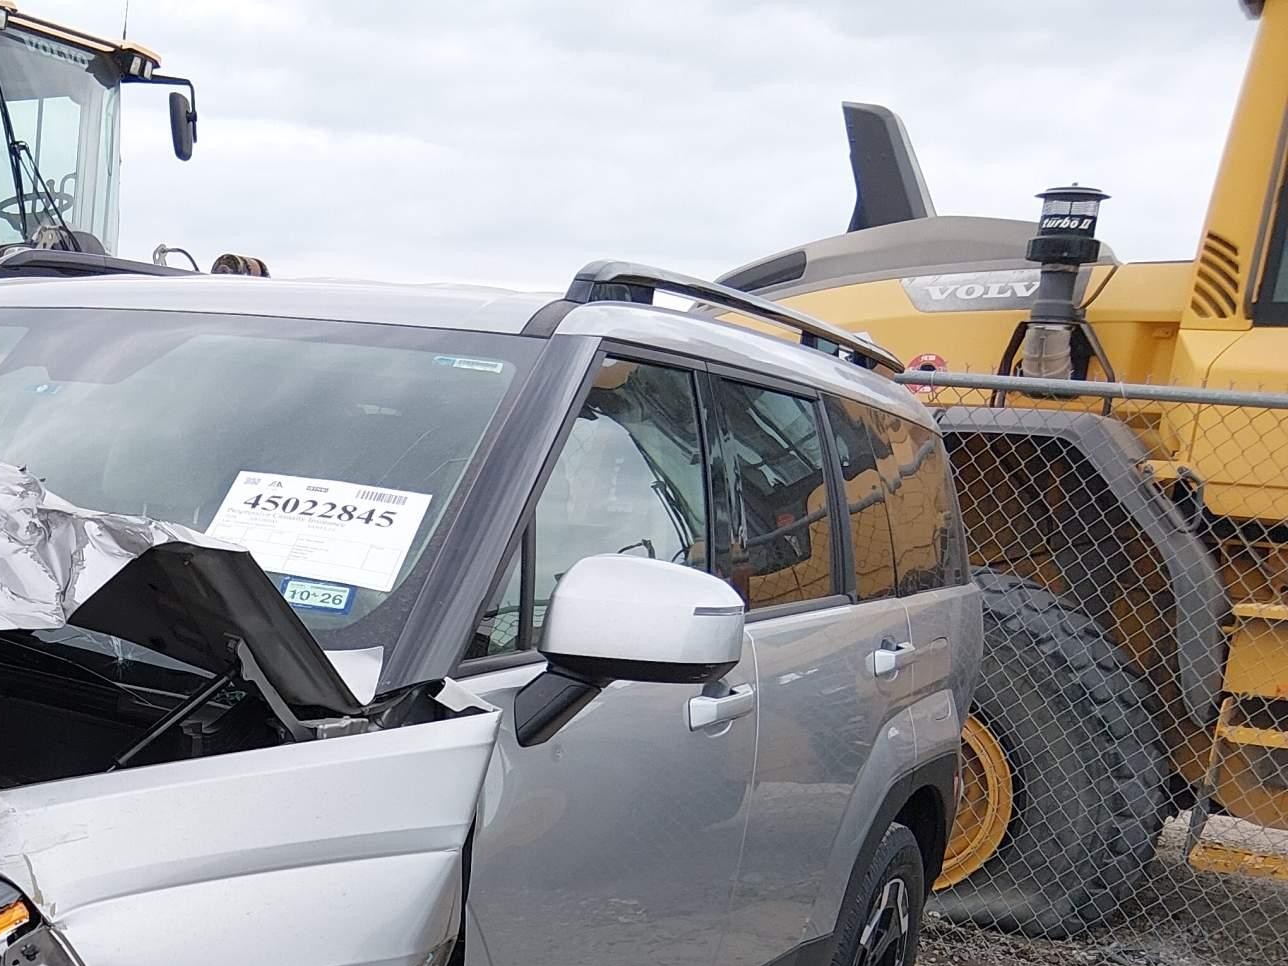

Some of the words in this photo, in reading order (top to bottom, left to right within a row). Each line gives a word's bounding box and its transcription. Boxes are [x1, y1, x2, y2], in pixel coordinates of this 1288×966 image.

[1041, 216, 1080, 229] turbo
[924, 281, 1041, 301] VOLV
[243, 492, 398, 529] 45022845
